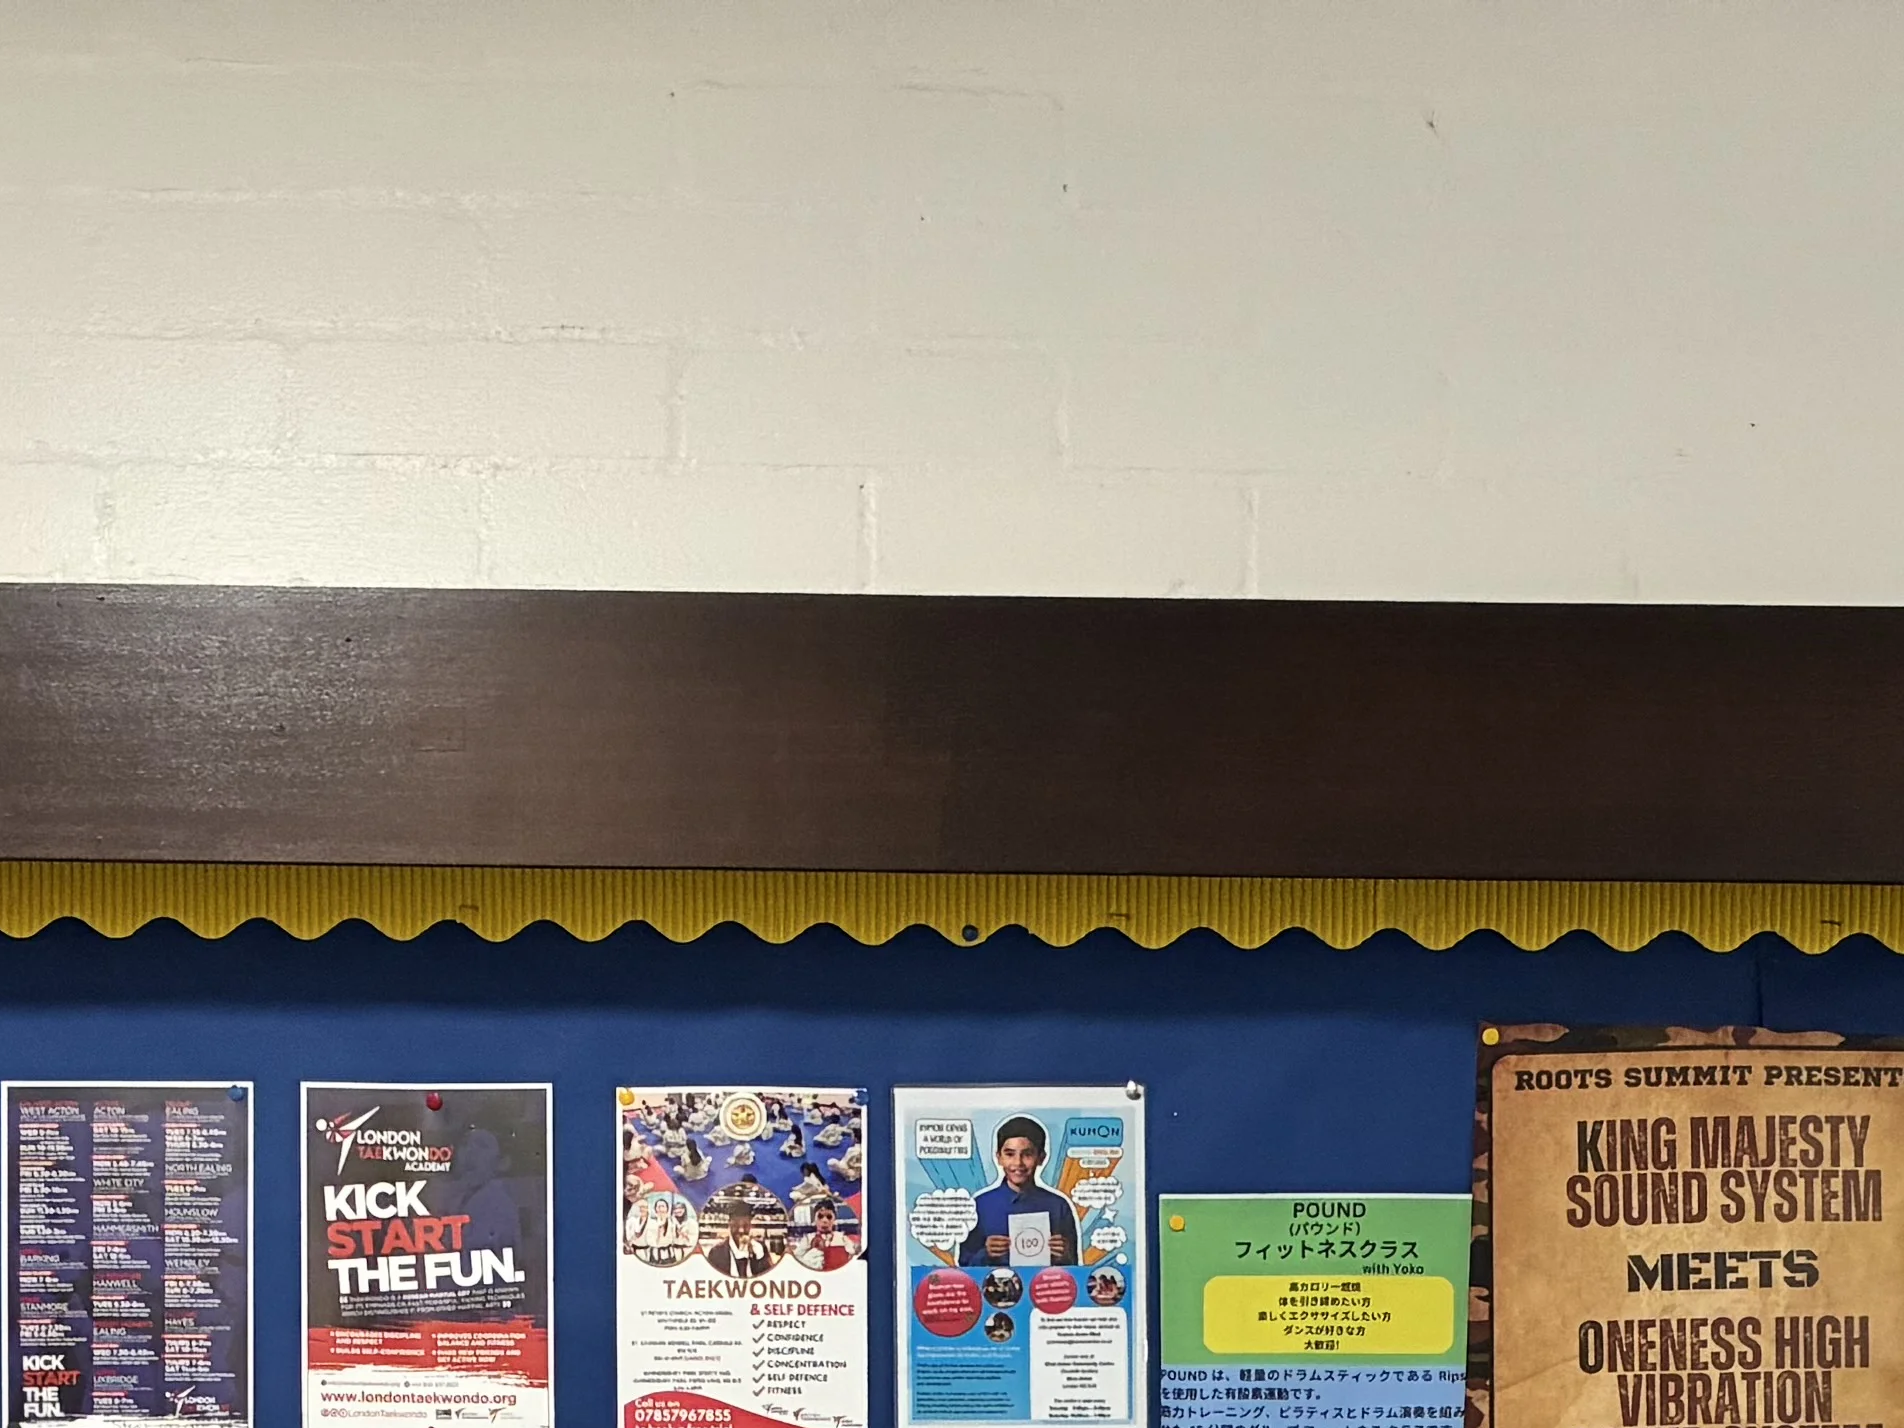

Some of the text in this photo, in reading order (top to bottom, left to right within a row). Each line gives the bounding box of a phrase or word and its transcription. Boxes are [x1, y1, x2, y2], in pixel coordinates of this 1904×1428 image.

[1514, 1068, 1613, 1090] ROOTS
[1624, 1066, 1752, 1088] SUMMIT
[356, 1130, 421, 1145] LONDON
[1070, 1125, 1120, 1138] KUMON
[359, 1146, 451, 1161] TAEKWONDO
[1576, 1115, 1871, 1173] KING MAJESTY
[405, 1162, 450, 1172] ACADEMY
[324, 1180, 429, 1222] KICK
[1566, 1169, 1883, 1228] SOUND SYSTEM
[1292, 1202, 1366, 1219] POUND
[327, 1215, 470, 1255] START
[1021, 1238, 1041, 1249] 100
[1235, 1241, 1419, 1260] フィットネスクラス
[328, 1248, 525, 1294] THE FUN.
[1627, 1249, 1820, 1292] MEETS
[663, 1280, 821, 1299] TAEKWONDO
[750, 1303, 855, 1316] & SELF DEFENCE
[1578, 1316, 1870, 1374] ONENESS HIGH
[321, 1391, 517, 1406] www.londontaekwondo.org
[1616, 1371, 1832, 1427] VIBRATION
[635, 1409, 732, 1422] 07857967855
